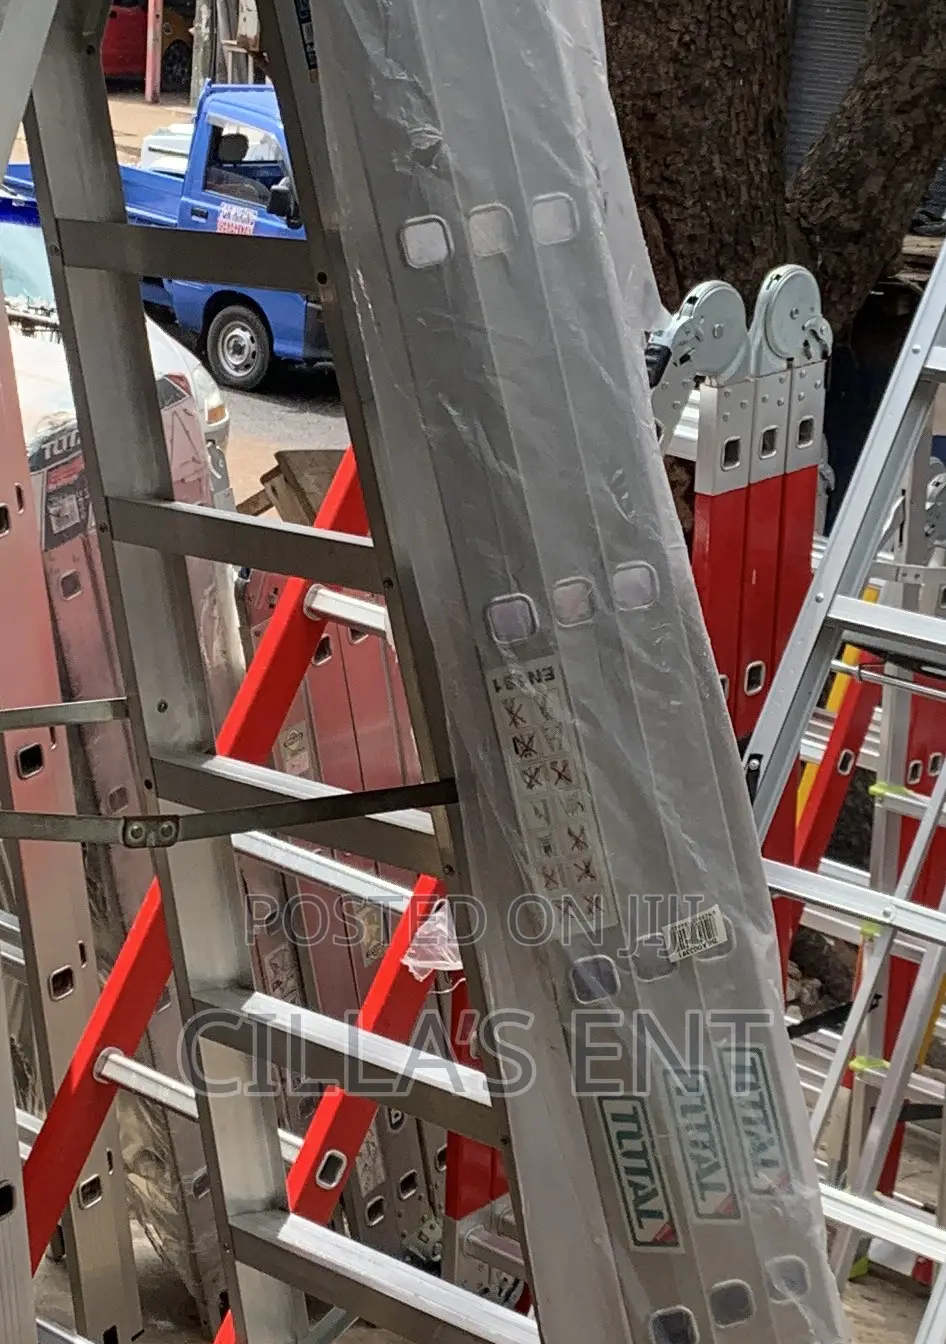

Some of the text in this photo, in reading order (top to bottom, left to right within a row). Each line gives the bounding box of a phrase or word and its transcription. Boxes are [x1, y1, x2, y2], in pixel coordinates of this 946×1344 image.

[41, 428, 81, 461] TOT
[610, 1105, 665, 1230] TOTAL
[674, 1072, 728, 1203] TOTAL
